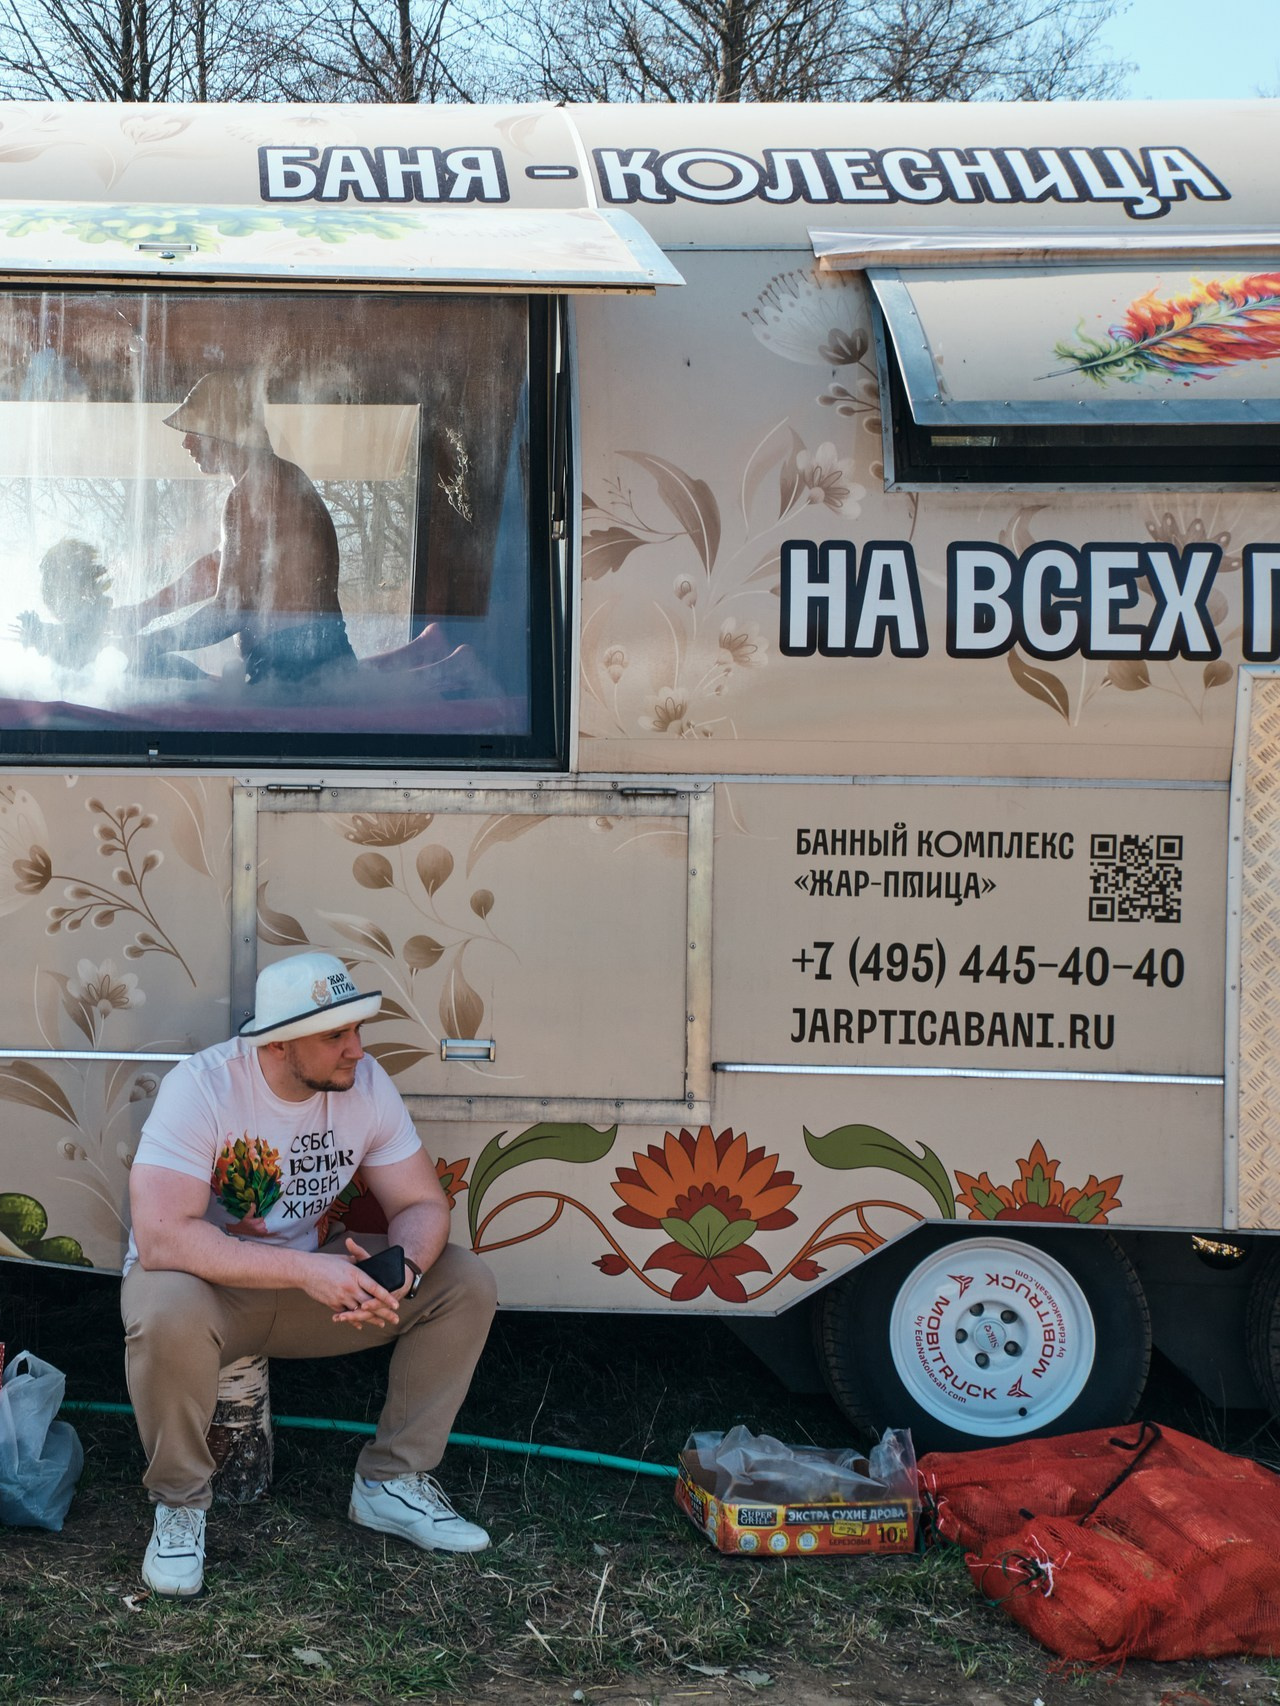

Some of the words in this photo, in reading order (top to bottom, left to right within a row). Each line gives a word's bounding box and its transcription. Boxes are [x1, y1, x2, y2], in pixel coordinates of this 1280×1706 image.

[259, 145, 510, 204] БАНЯ
[592, 147, 1231, 219] КОЛЕСНИЦА
[780, 540, 929, 658] НА
[946, 541, 1222, 661] ВСЕХ
[795, 822, 908, 858] БАННЫЙ
[917, 829, 1075, 860] КОМПЛЕКС
[791, 941, 835, 981] +7
[848, 936, 947, 988] (495)
[959, 945, 1186, 988] 445-40-40
[790, 1007, 1116, 1050] JARPTICABANI.RU
[285, 1171, 340, 1196] СВОЕЙ
[281, 1196, 335, 1219] ЖИЗН
[985, 1273, 1056, 1379] MOBITRUCK
[926, 1295, 998, 1400] MOBITRUCK
[740, 1515, 770, 1525] GRILL
[741, 1508, 772, 1518] SUPER
[788, 1510, 829, 1522] ЭКСТРА
[832, 1509, 867, 1520] СУХИЕ
[869, 1507, 905, 1520] ДРОВА
[878, 1526, 898, 1544] 10
